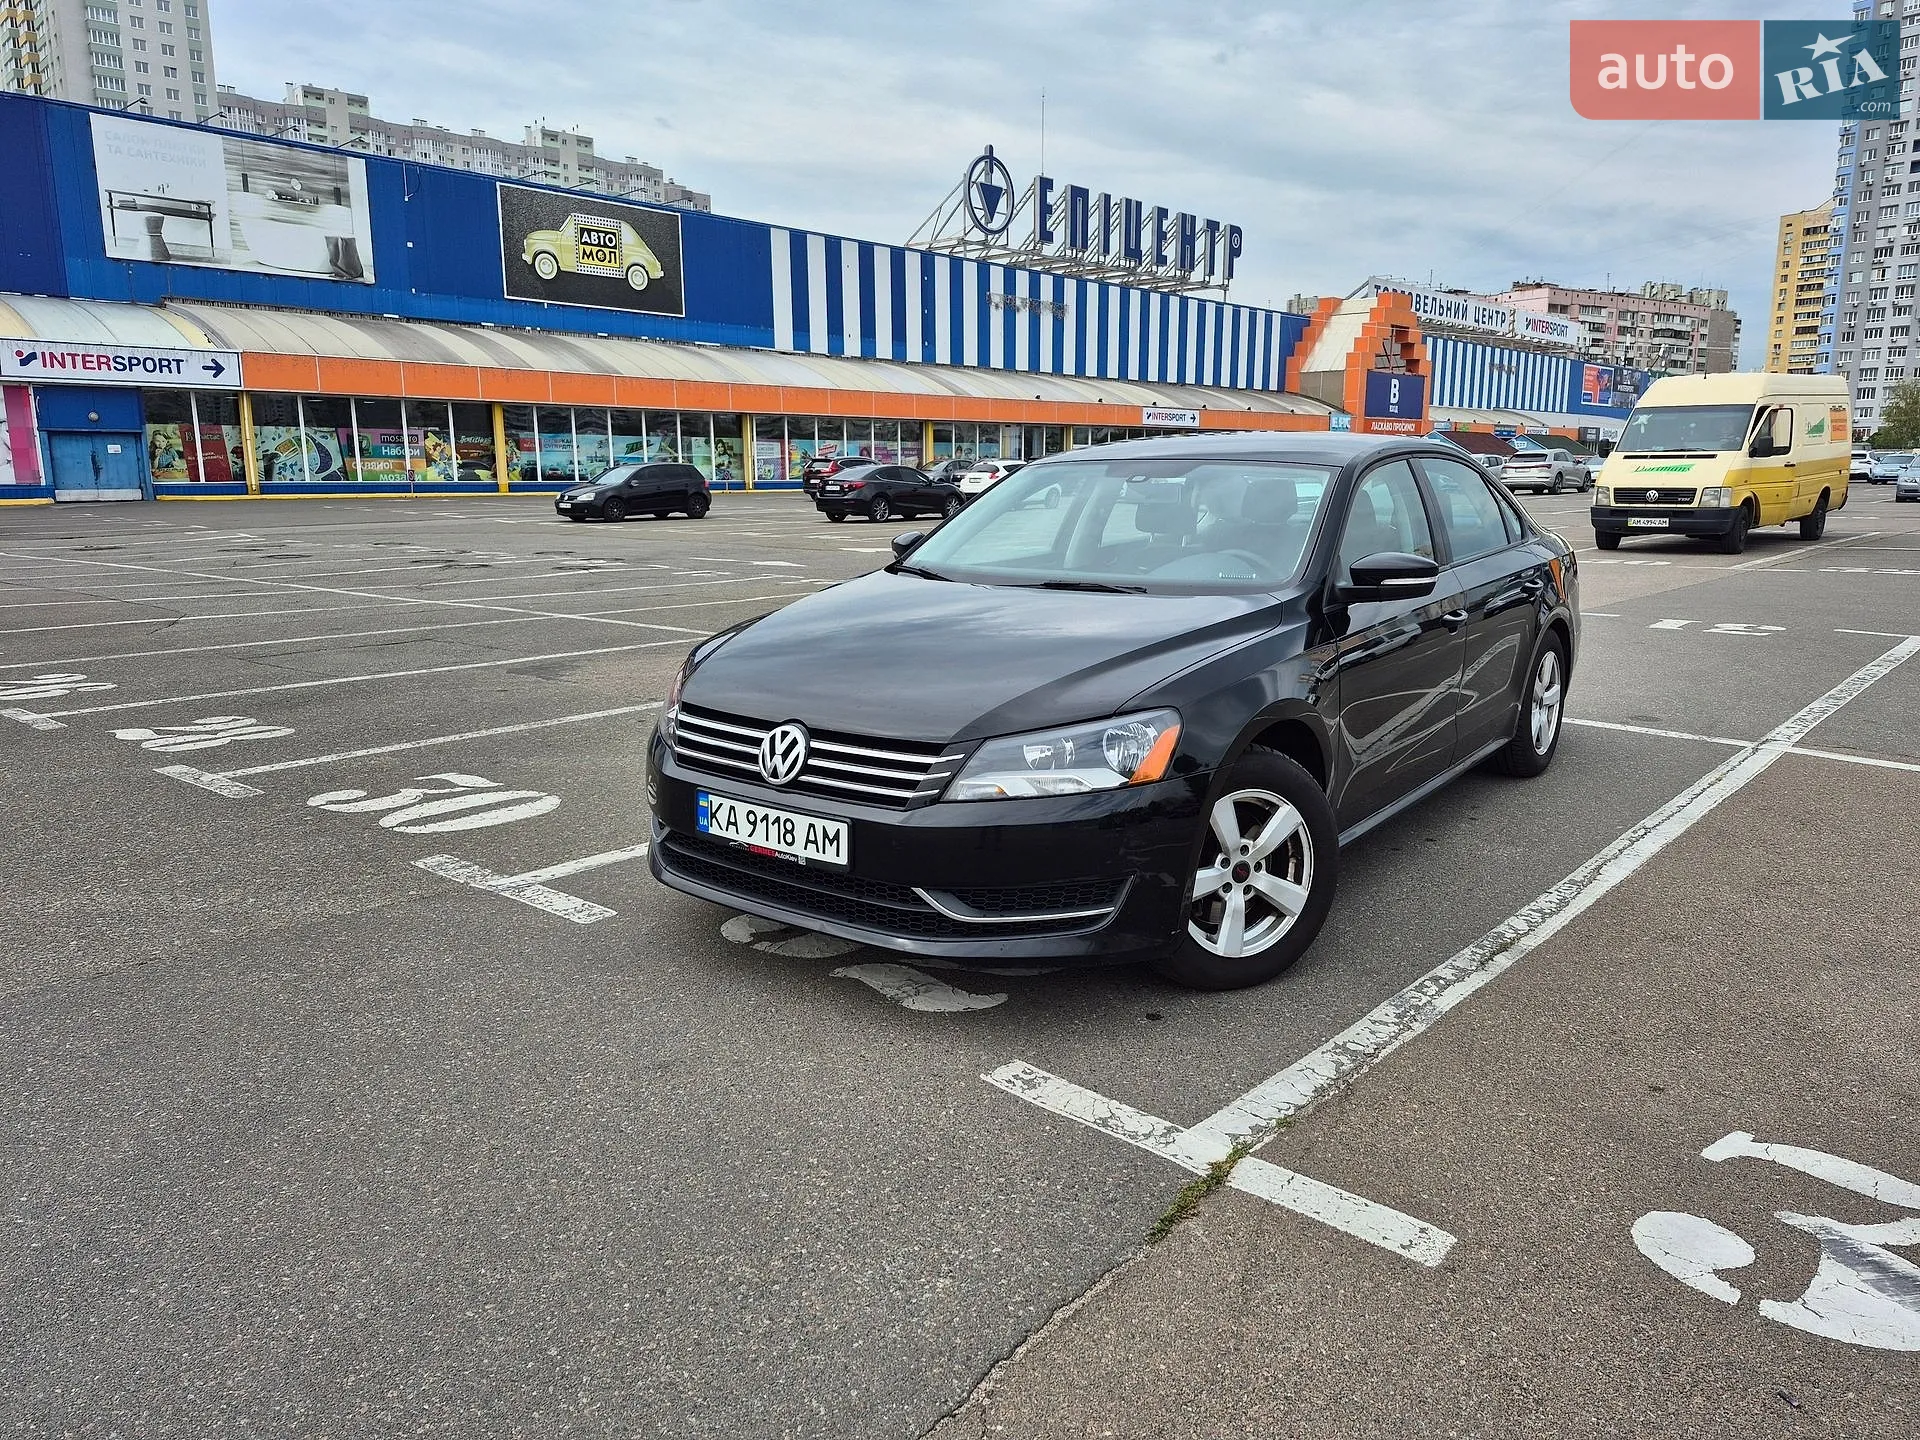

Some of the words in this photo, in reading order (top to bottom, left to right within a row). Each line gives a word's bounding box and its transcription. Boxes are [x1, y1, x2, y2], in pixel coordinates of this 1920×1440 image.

[1034, 175, 1243, 280] ЕПІЦЕНТР
[581, 230, 616, 247] АВТО
[581, 247, 617, 264] МОЛ
[1374, 284, 1469, 322] ТОВЕЛЬНИЙ
[1474, 306, 1507, 329] ЦЕНТР
[1531, 317, 1569, 338] INTERSPORT
[41, 351, 185, 375] INTERSPORT
[1152, 412, 1187, 422] INTERSPORT
[381, 435, 418, 443] mosaro
[699, 817, 708, 826] UA
[709, 799, 740, 835] KA
[745, 809, 796, 847] 9118
[803, 822, 841, 858] AM
